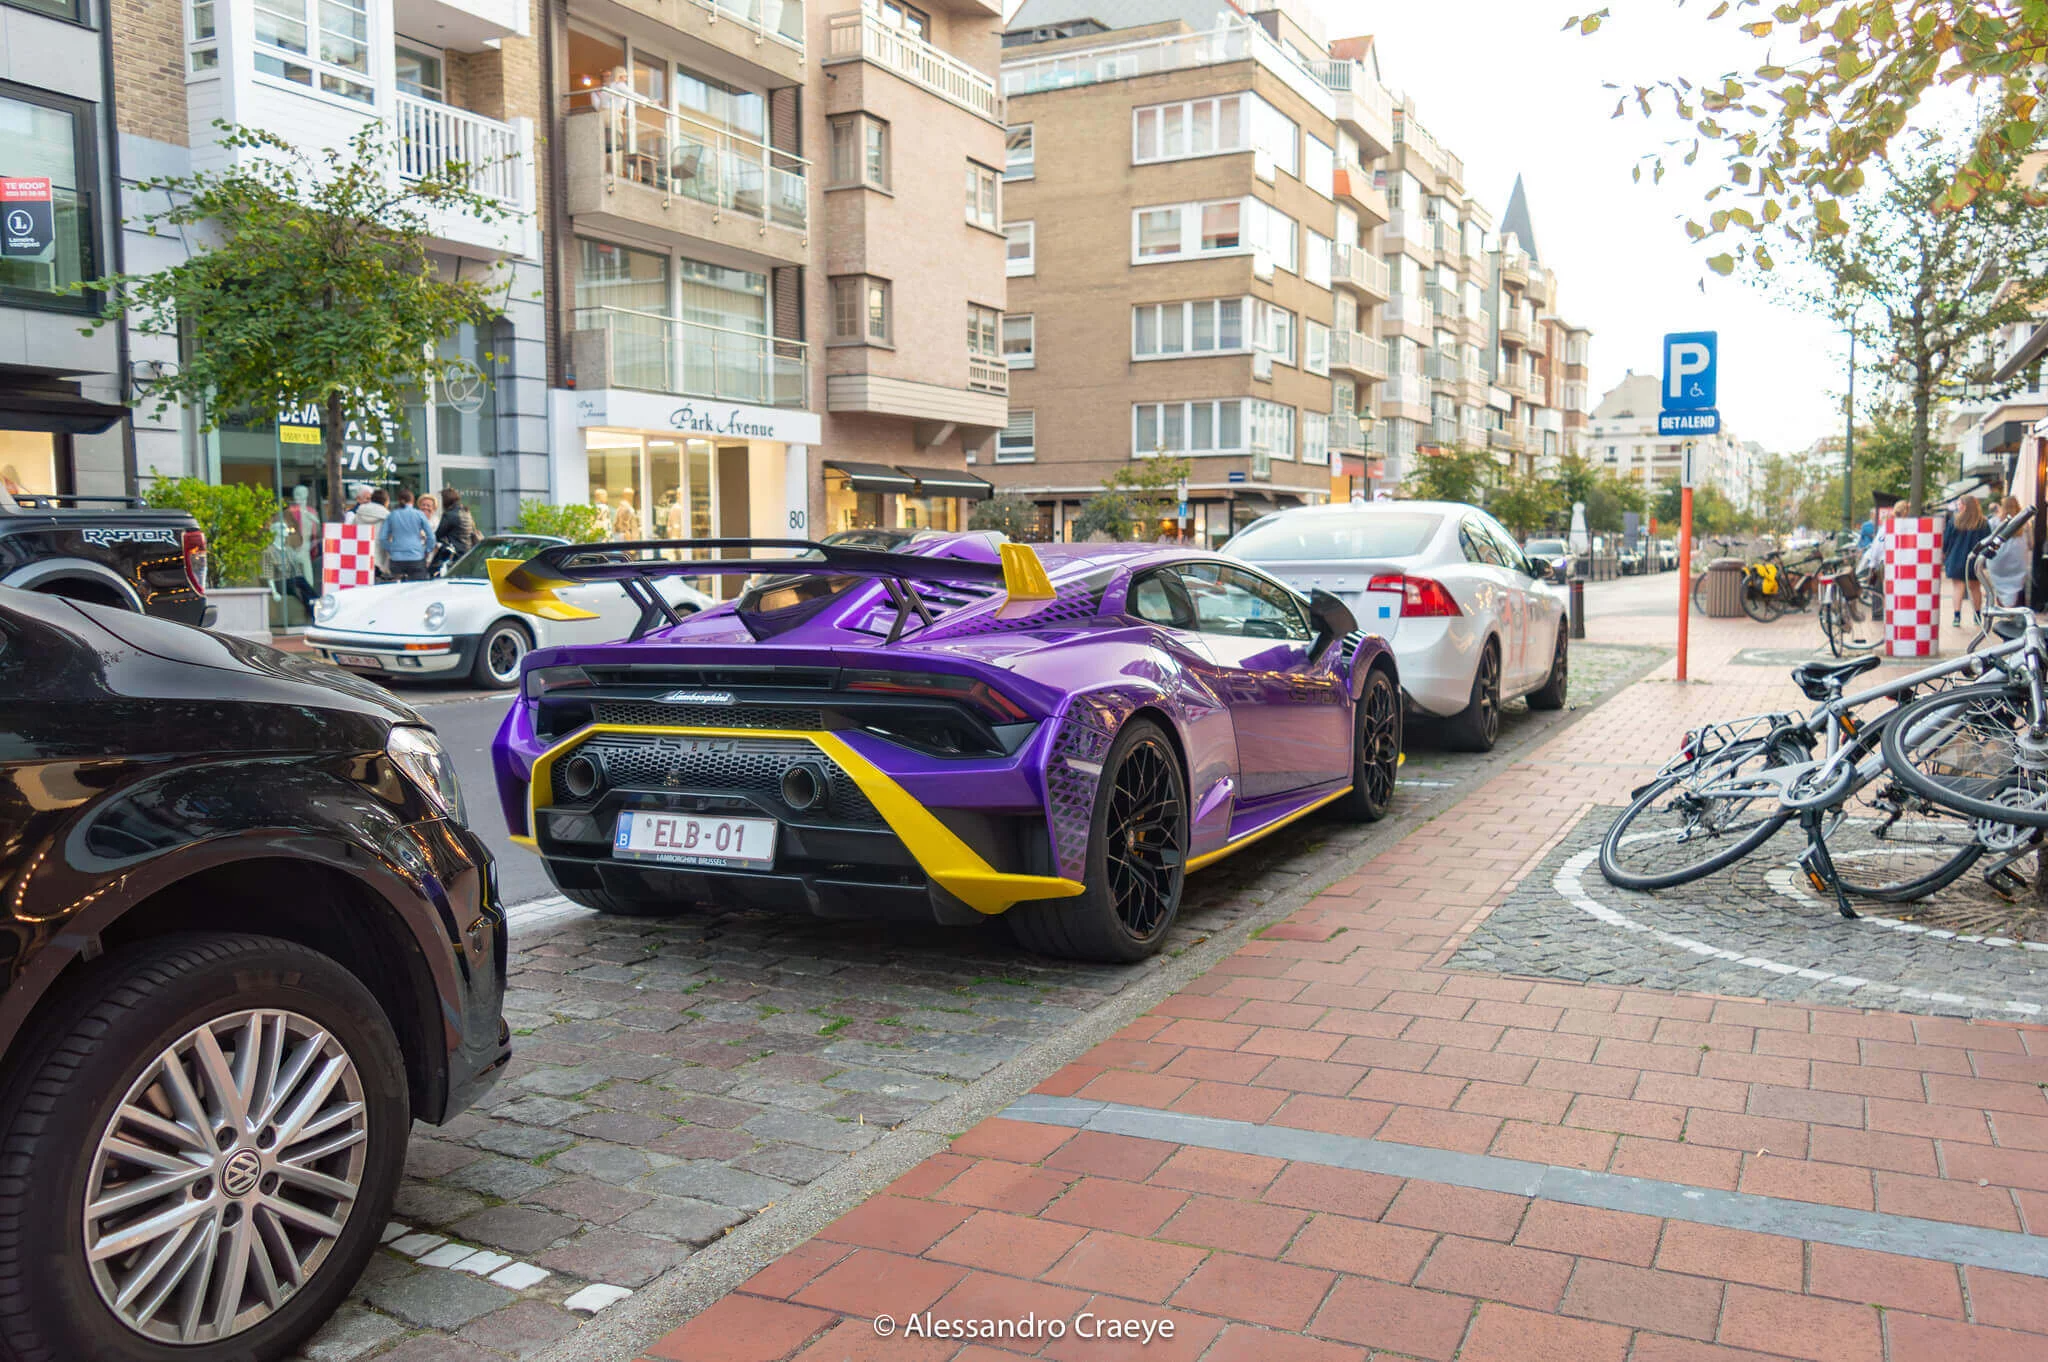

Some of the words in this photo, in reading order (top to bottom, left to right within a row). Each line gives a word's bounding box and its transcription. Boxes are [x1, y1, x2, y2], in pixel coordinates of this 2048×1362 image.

[1669, 342, 1710, 398] P
[670, 402, 713, 430] Park
[716, 409, 775, 438] Avenue
[1661, 415, 1715, 430] BETALEND
[789, 510, 805, 530] 80
[82, 528, 179, 548] RAPTOR
[670, 690, 731, 704] Lamborghini
[619, 833, 629, 846] B
[655, 819, 745, 852] ELB-01
[698, 856, 727, 866] BRUSSELS
